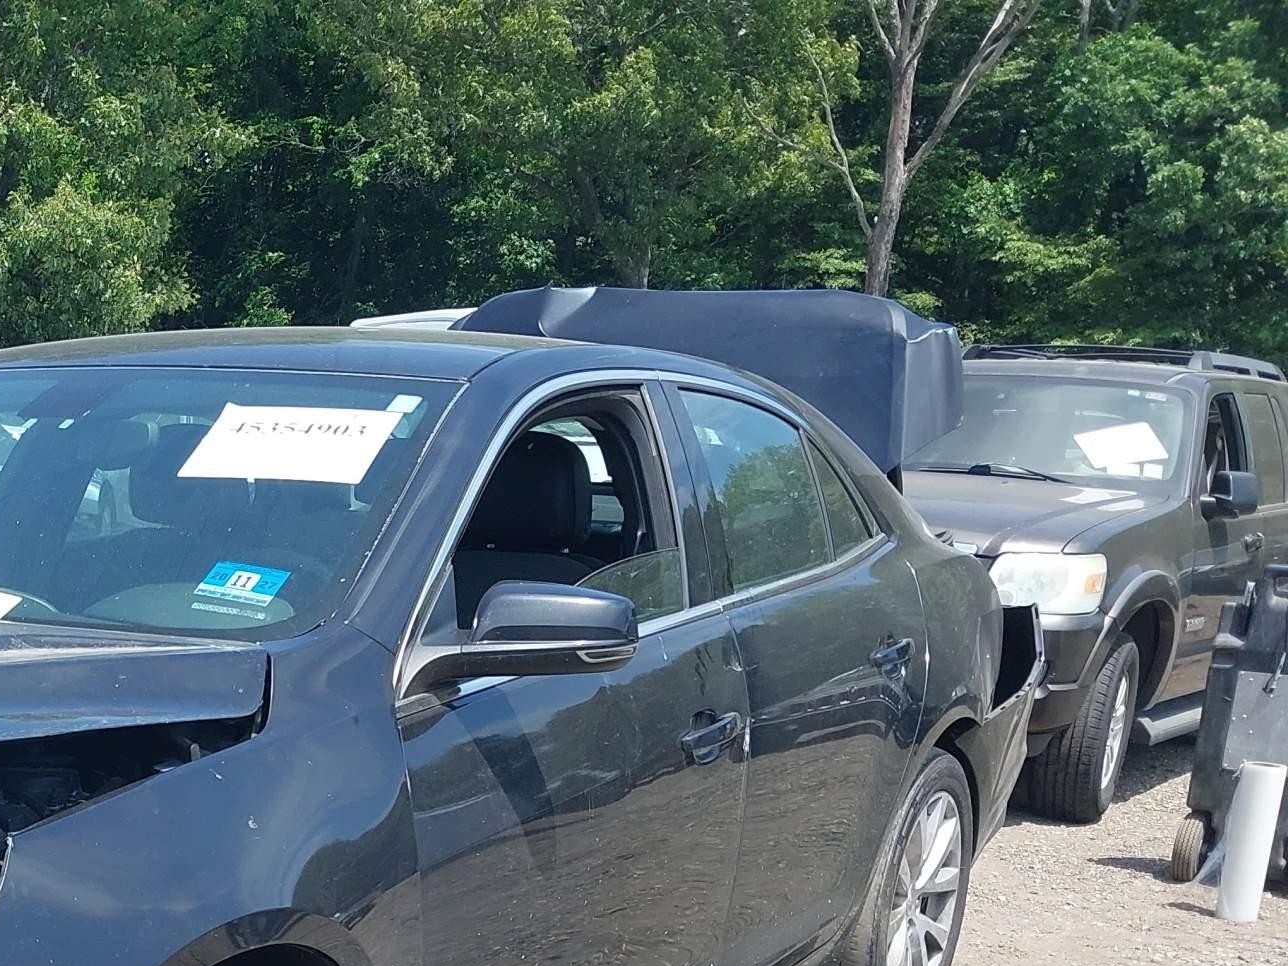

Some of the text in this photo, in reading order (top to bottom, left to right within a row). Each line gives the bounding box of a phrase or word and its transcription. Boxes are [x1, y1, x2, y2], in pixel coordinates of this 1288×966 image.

[210, 572, 277, 590] 20 11 27
